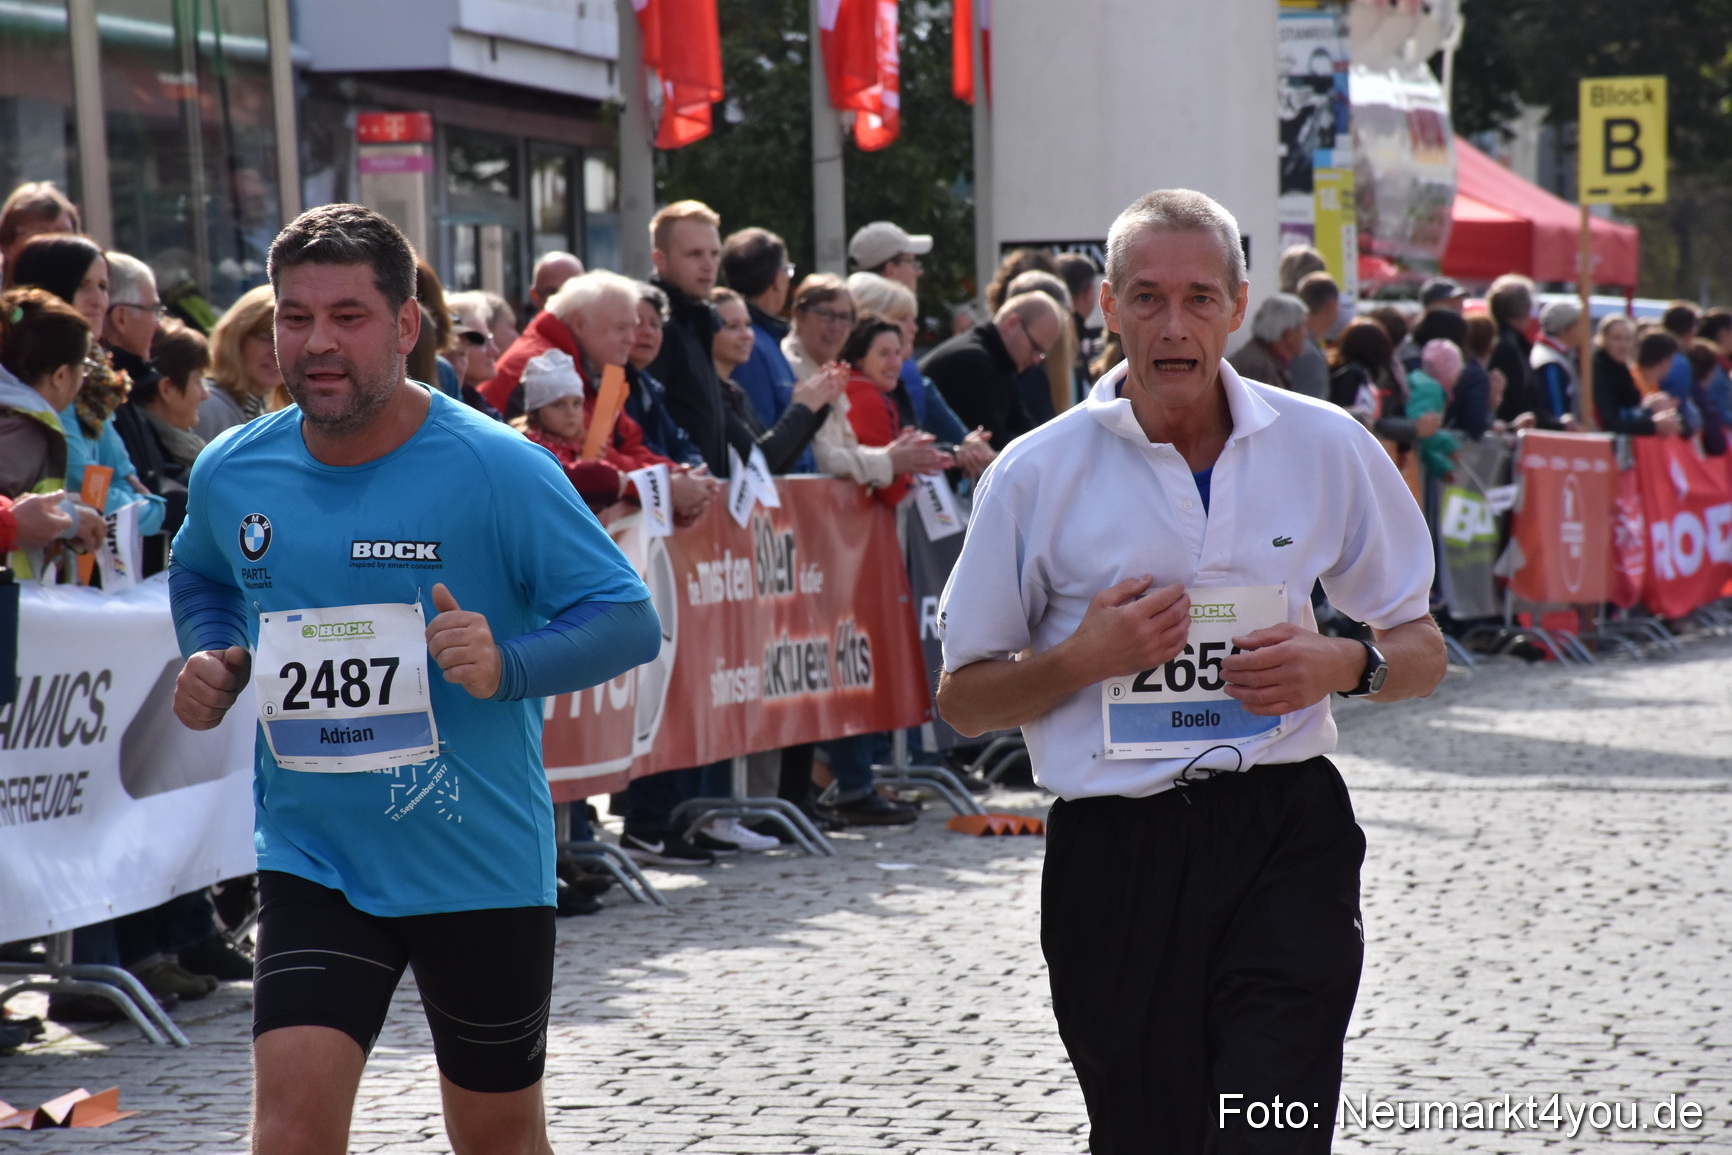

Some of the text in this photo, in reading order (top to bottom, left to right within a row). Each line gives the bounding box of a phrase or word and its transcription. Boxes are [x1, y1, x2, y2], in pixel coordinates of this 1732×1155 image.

[1590, 84, 1656, 108] Block
[1604, 118, 1643, 175] B
[351, 541, 440, 561] BOCK
[349, 560, 375, 569] inspired
[377, 561, 385, 569] by
[241, 567, 272, 580] PARTL
[244, 581, 273, 590] Neumarkt
[1189, 604, 1236, 618] OCK
[318, 621, 375, 637] BOCK
[1132, 641, 1241, 693] 265
[279, 657, 400, 711] 2487
[1113, 687, 1120, 697] D
[267, 706, 273, 715] D
[1171, 709, 1221, 728] Boelo
[320, 727, 374, 744] Adrian
[391, 764, 448, 821] 17. September 2017
